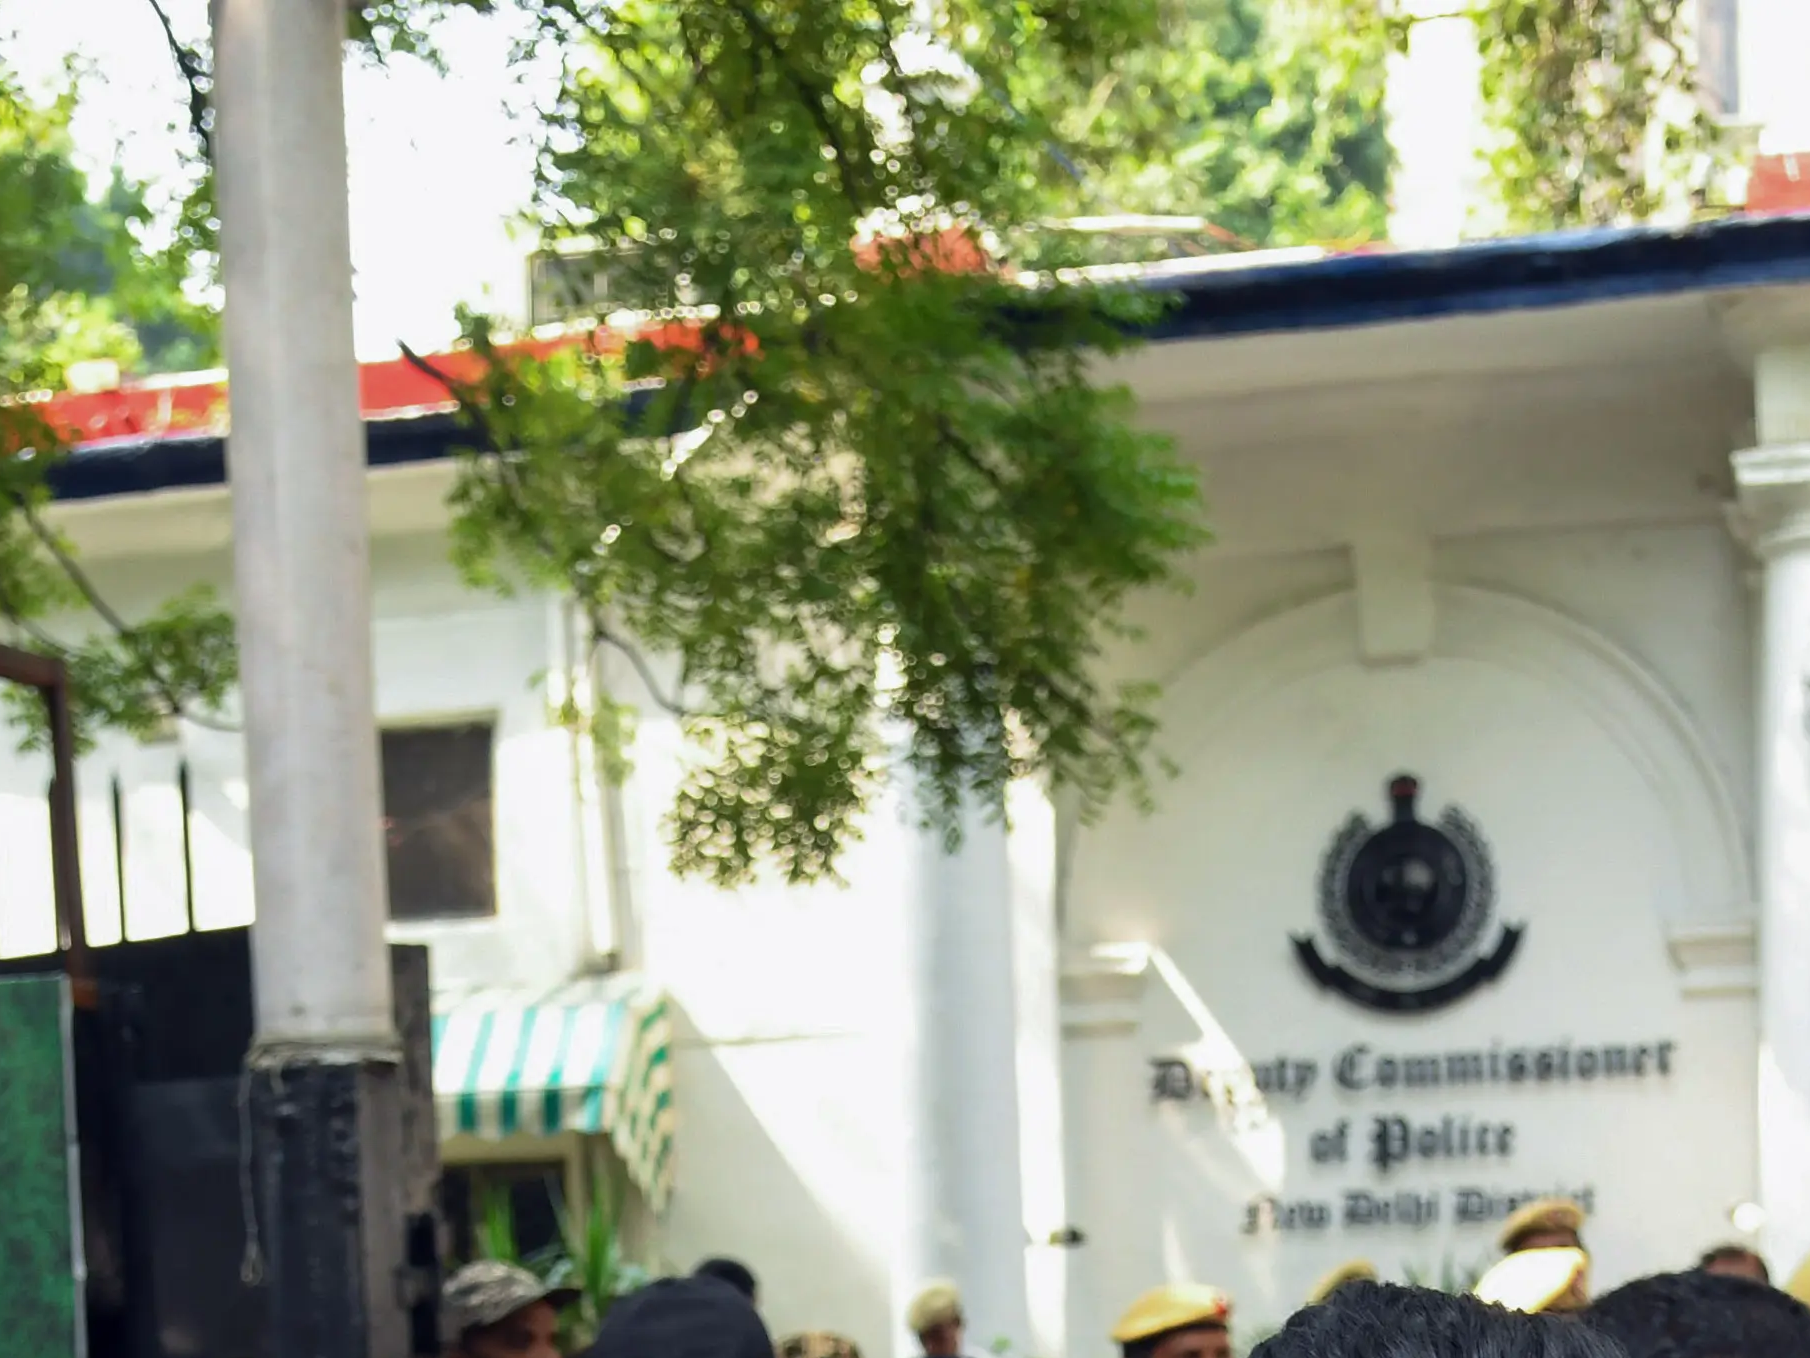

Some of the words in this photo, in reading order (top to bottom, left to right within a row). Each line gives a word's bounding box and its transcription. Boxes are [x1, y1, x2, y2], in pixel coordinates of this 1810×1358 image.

[1331, 1036, 1677, 1090] Commissioner
[1308, 1119, 1349, 1165] of
[1368, 1113, 1516, 1175] Police
[1342, 1184, 1440, 1231] Delhi
